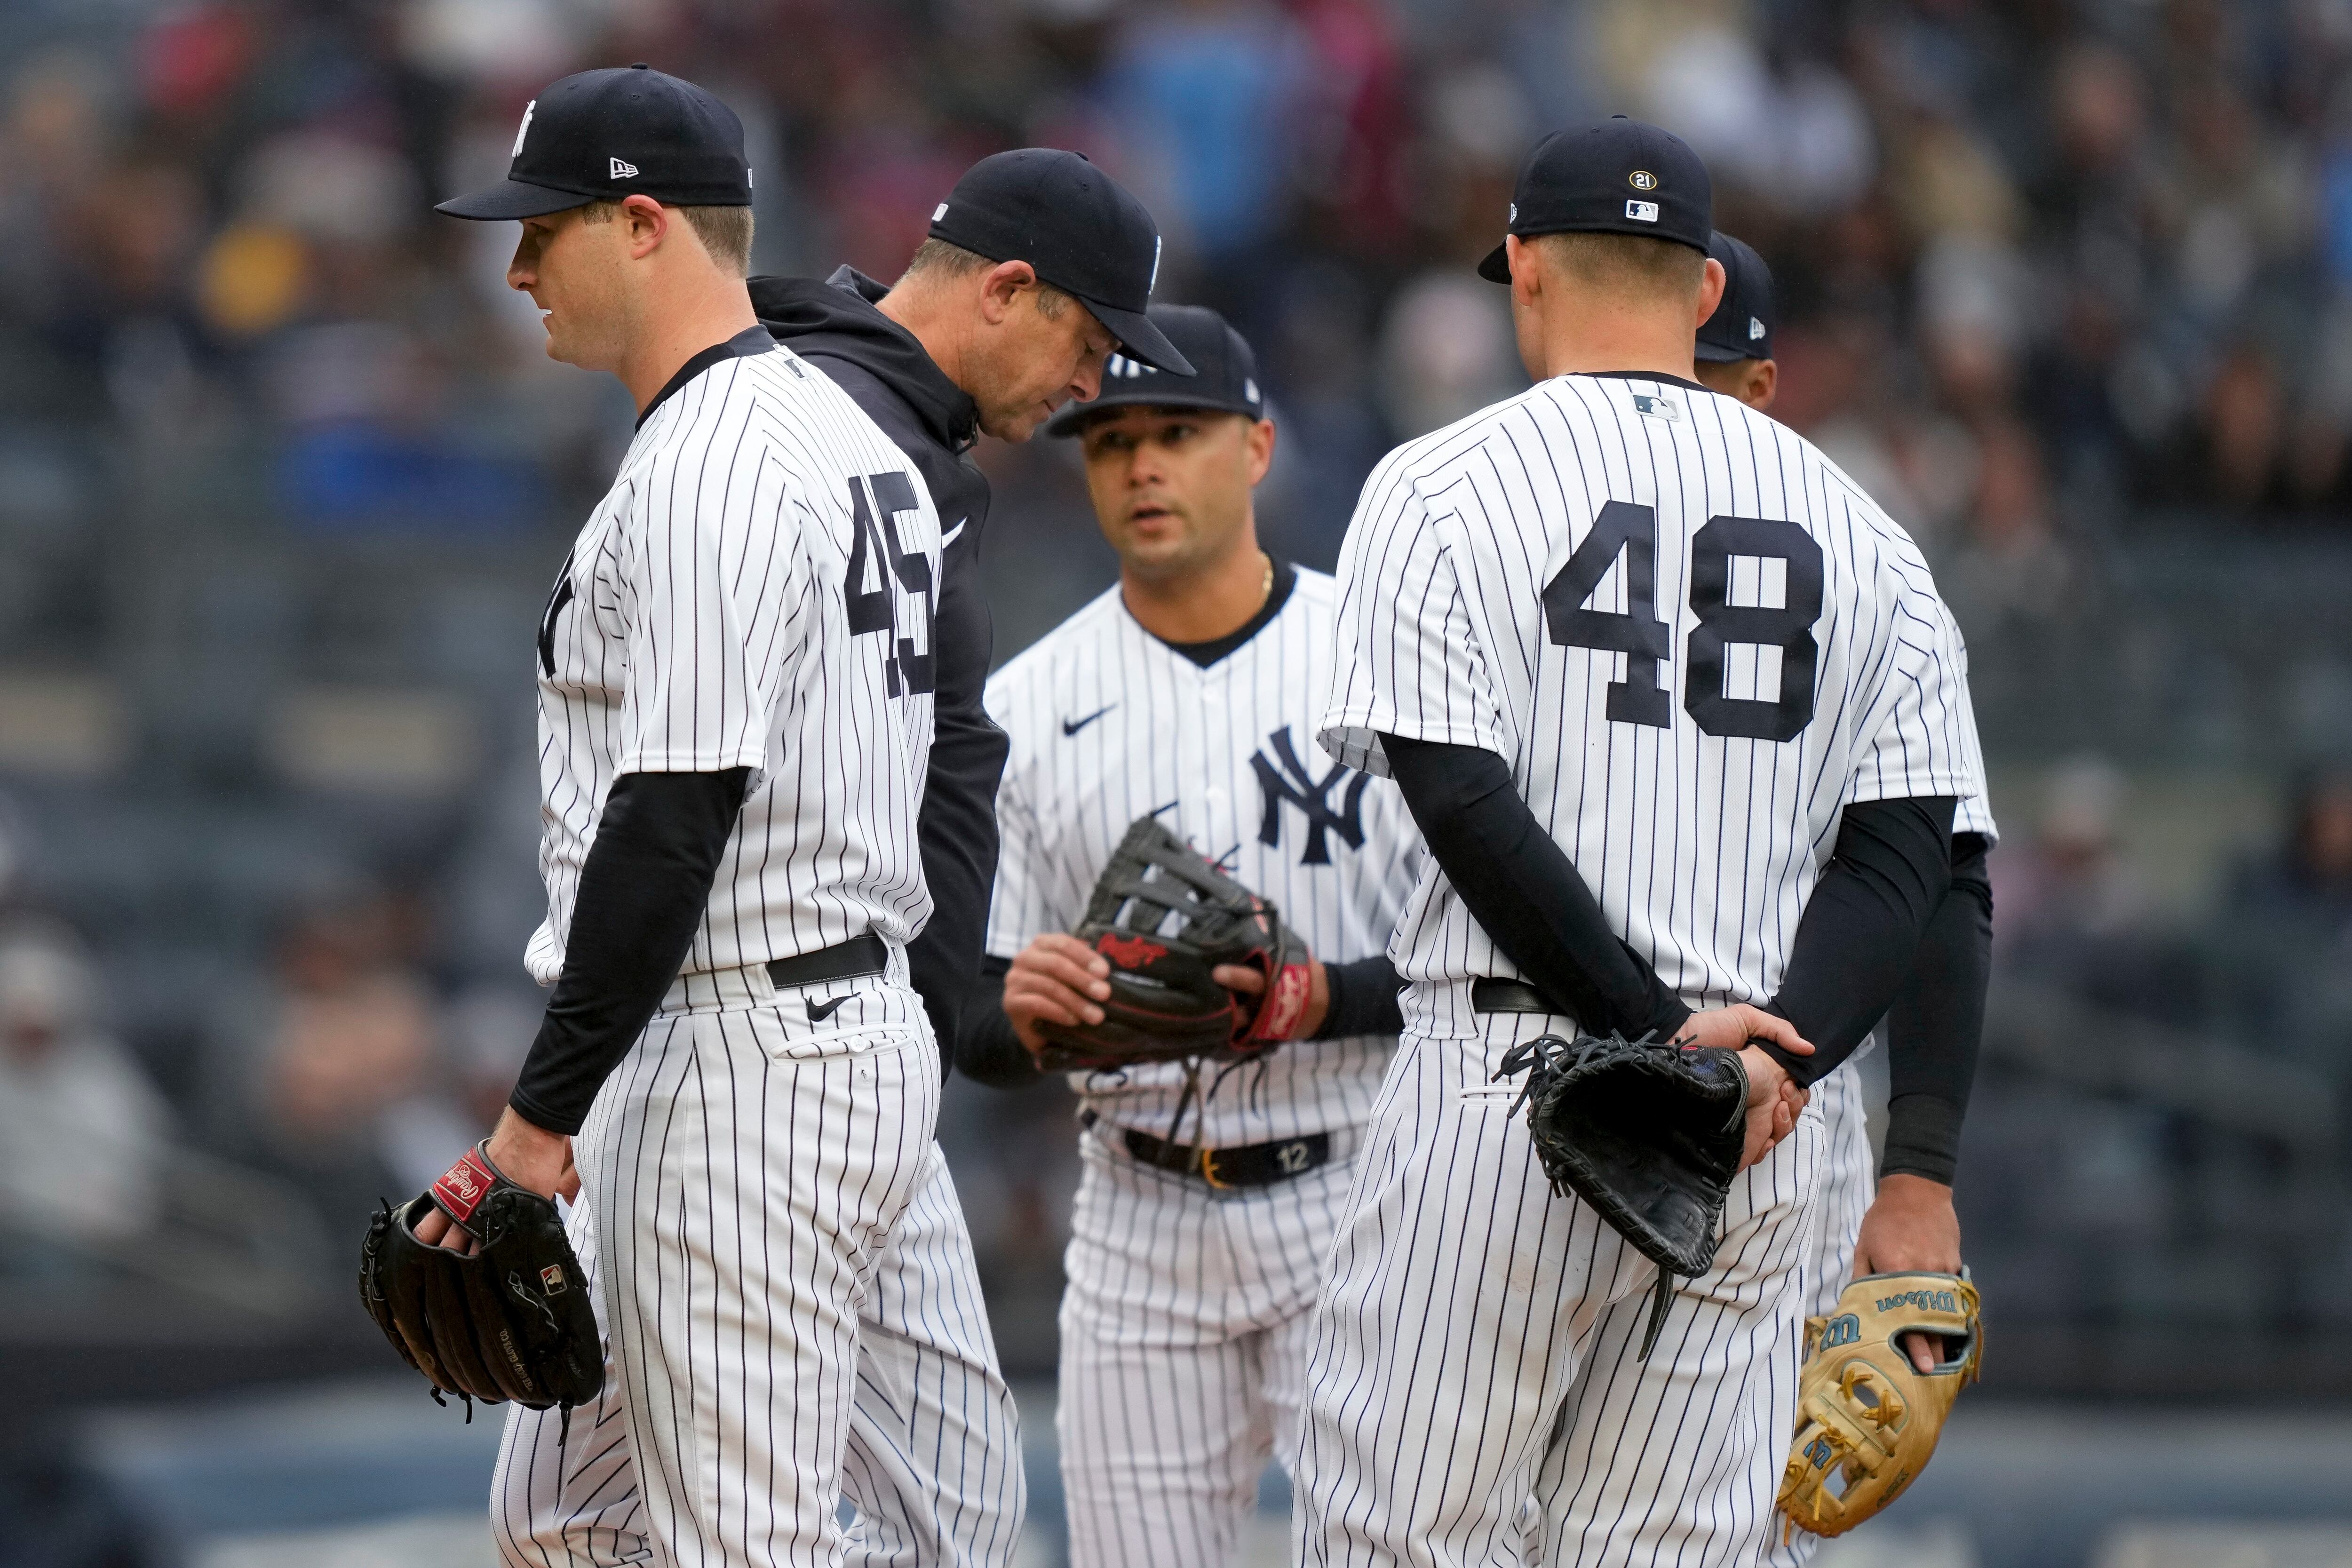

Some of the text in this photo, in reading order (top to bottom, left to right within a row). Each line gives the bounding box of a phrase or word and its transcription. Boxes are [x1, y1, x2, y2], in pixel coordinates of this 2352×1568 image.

[1636, 174, 1650, 187] 21
[844, 471, 937, 699] 45
[1541, 500, 1824, 743] 48
[1250, 725, 1373, 866] NY
[1277, 1142, 1310, 1174] 12
[1875, 1290, 1957, 1313] Wilson
